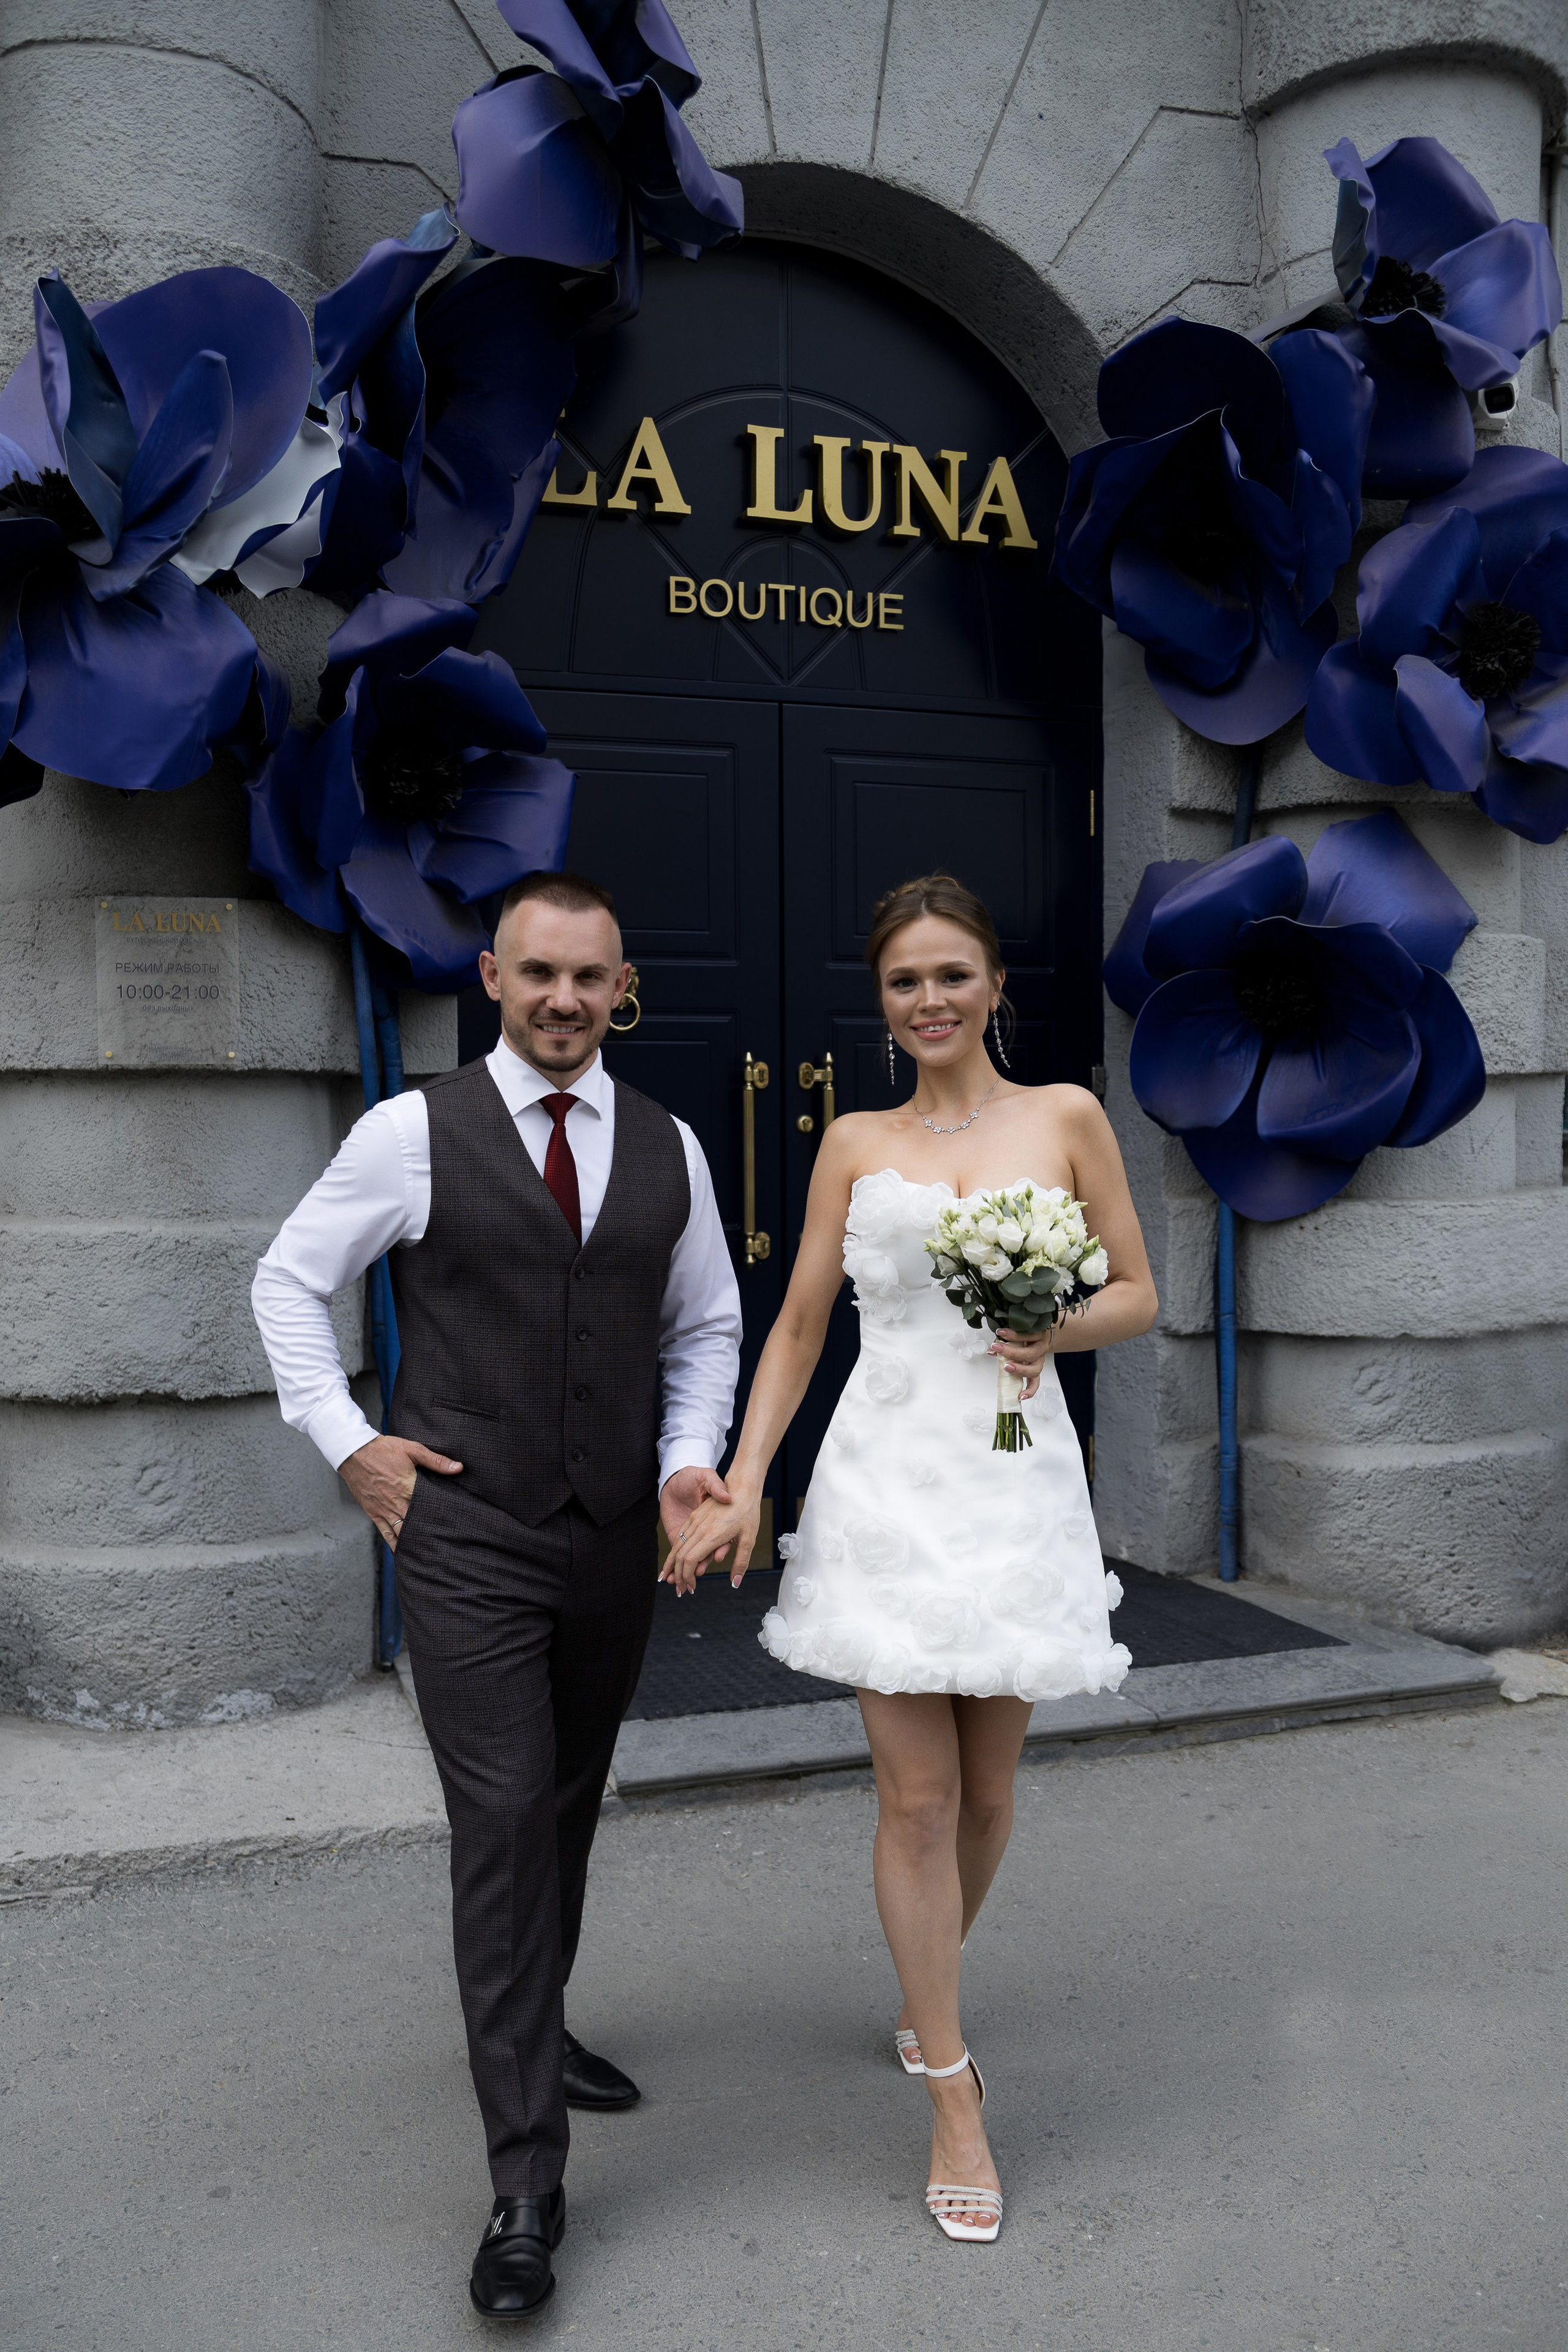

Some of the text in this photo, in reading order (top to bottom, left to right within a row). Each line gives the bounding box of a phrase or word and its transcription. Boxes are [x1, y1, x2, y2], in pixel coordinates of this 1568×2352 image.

[743, 424, 1038, 549] LUNA
[669, 576, 905, 630] BOUTIQUE
[112, 911, 222, 933] LA LUNA
[115, 962, 220, 974] РЕЖИМ РАБОТЫ
[116, 984, 221, 1000] 10:00-21:00
